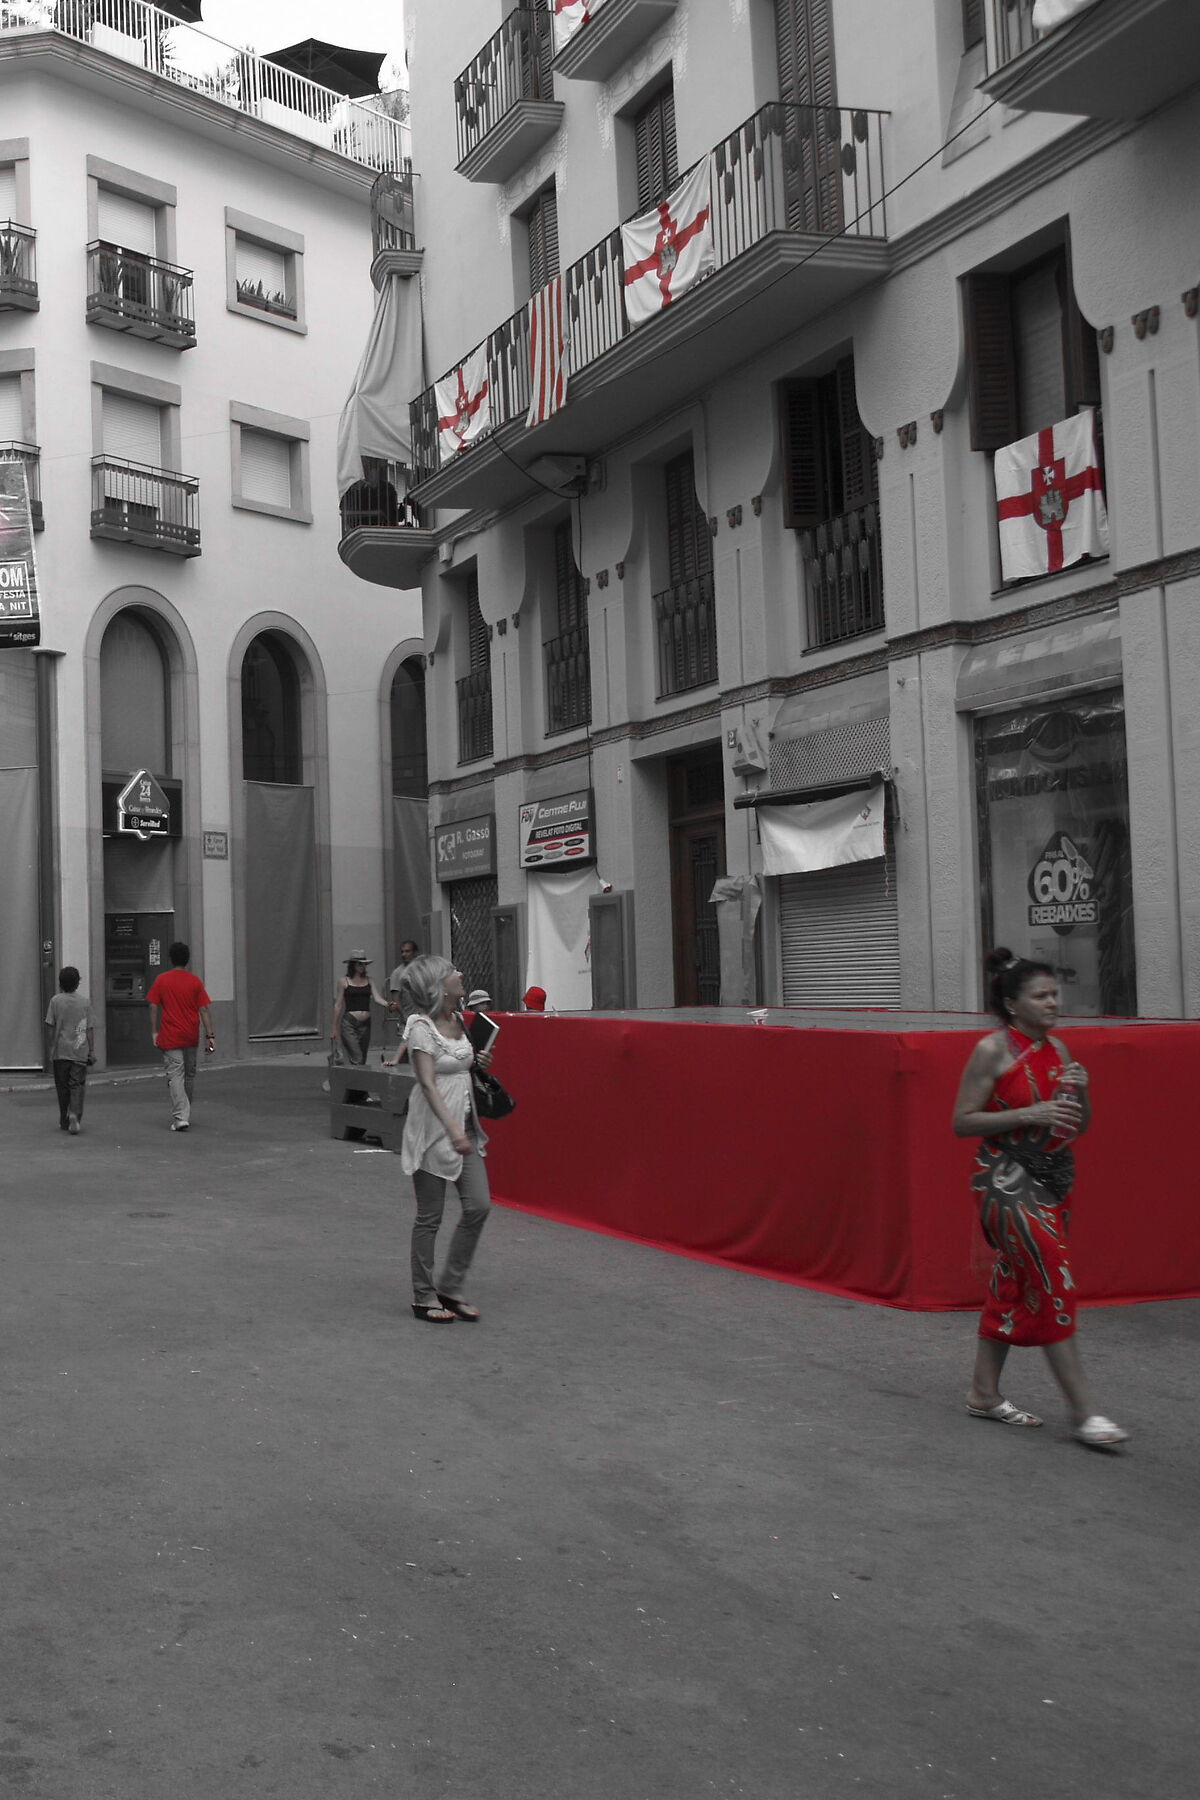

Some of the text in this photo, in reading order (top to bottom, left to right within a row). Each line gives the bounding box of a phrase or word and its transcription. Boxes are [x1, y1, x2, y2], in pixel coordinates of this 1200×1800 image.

[10, 602, 26, 610] NIT
[140, 786, 150, 796] 24
[569, 800, 587, 812] FUJI
[565, 822, 583, 833] DIGITAL
[1034, 859, 1090, 902] 60%
[1031, 903, 1095, 924] REBAIXES
